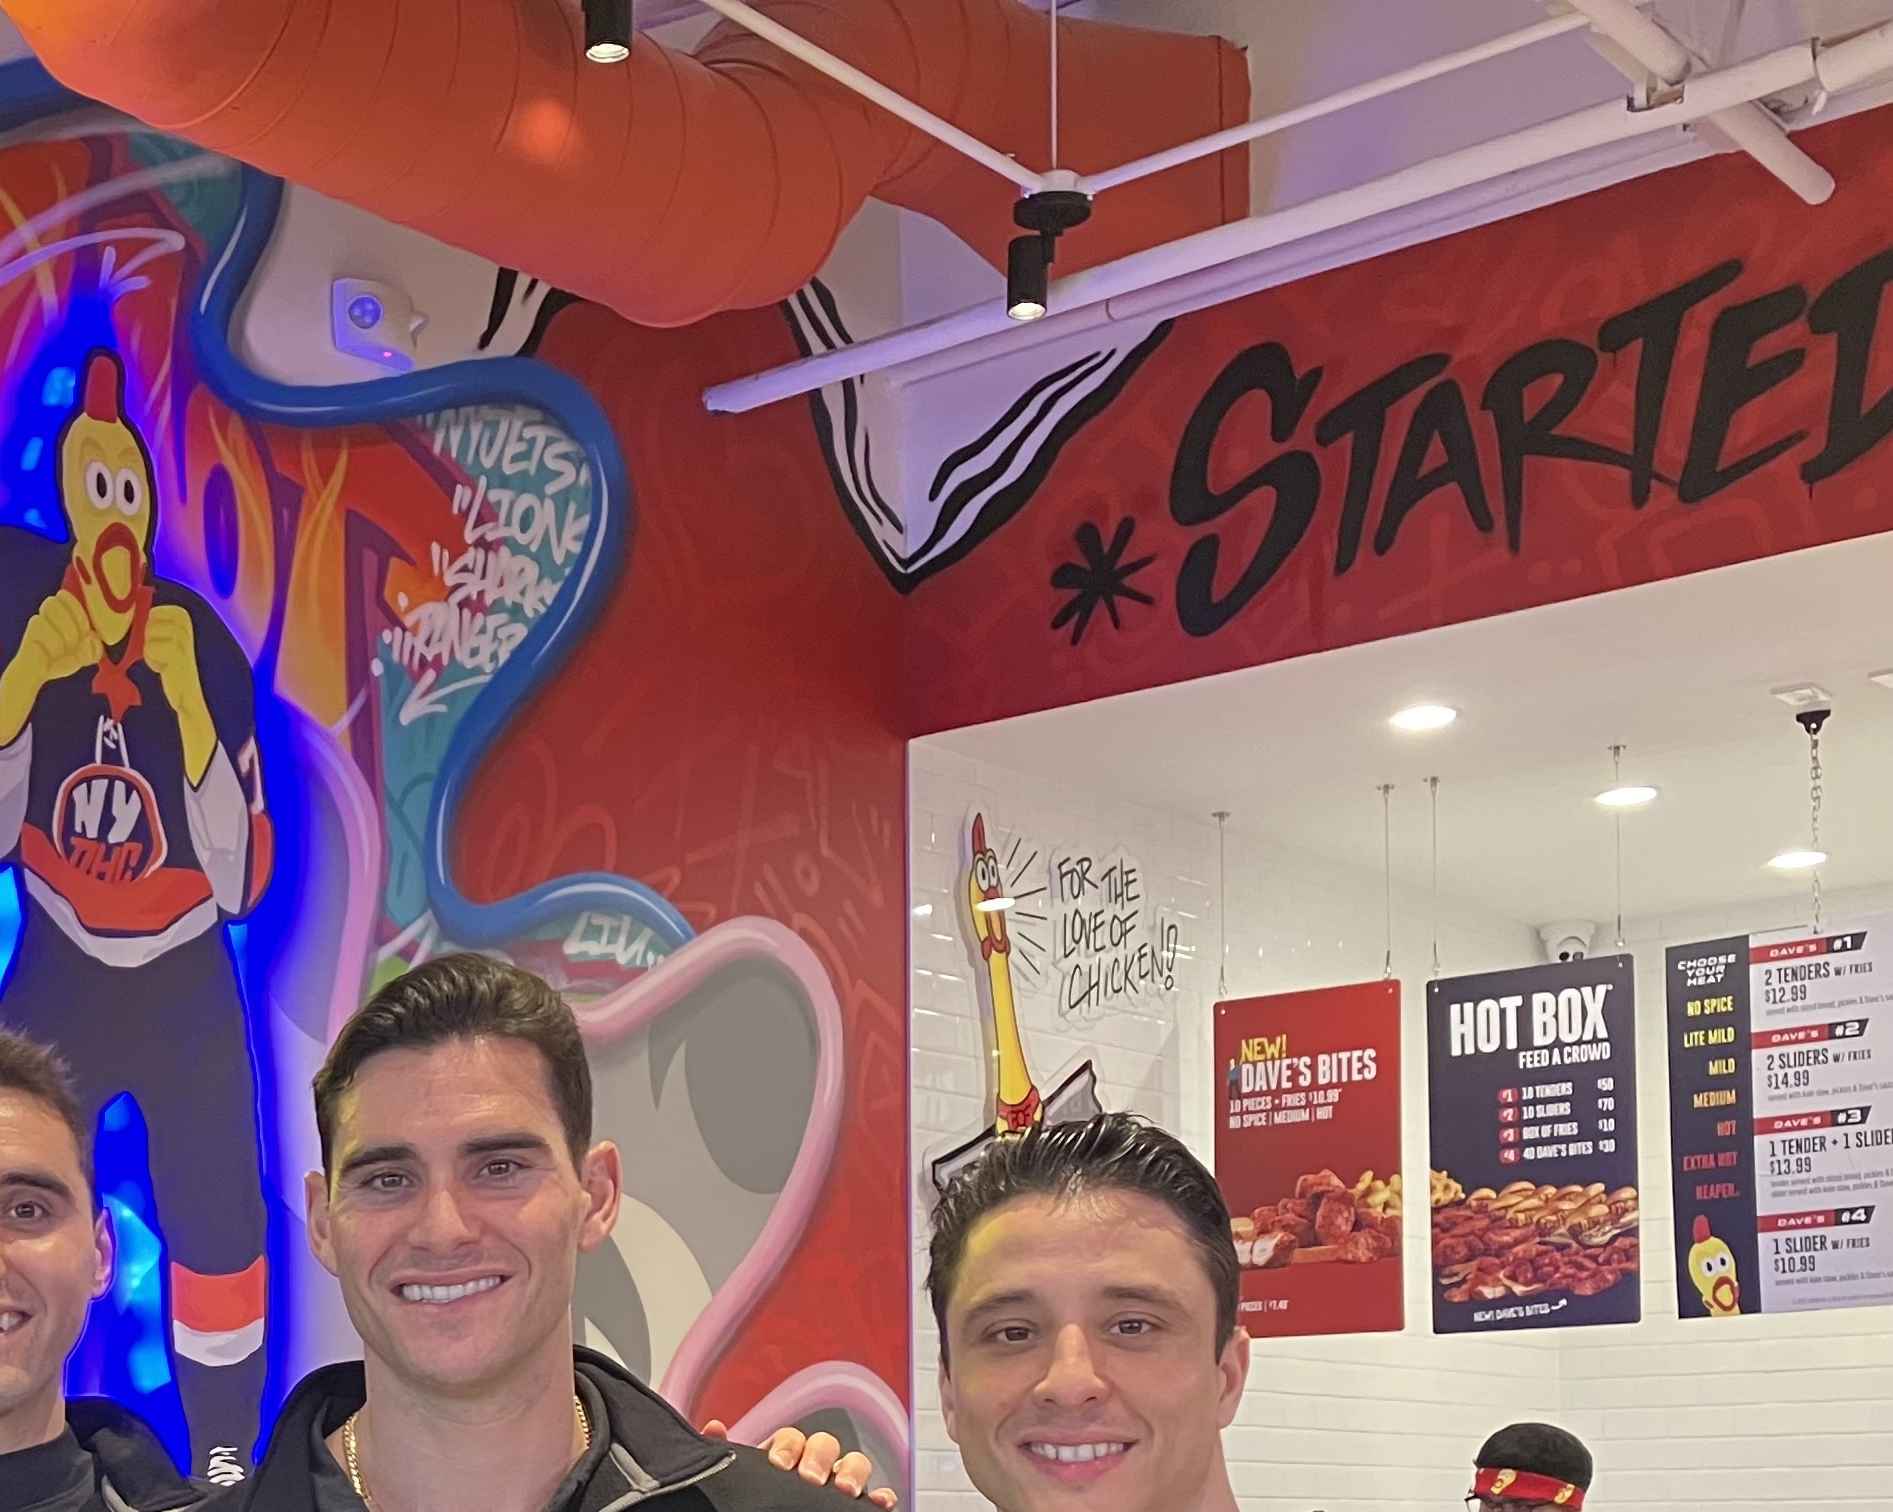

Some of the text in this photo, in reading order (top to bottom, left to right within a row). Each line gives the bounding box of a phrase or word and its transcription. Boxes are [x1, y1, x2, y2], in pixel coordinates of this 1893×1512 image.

[71, 778, 142, 843] NY
[1058, 856, 1141, 911] FOR THE
[1063, 908, 1139, 959] LOVE OF
[1769, 943, 1817, 958] DAVE'S
[1068, 916, 1178, 1010] CHICKEN!
[1677, 953, 1736, 970] CHOOSE
[1687, 965, 1725, 977] YOUR
[1687, 974, 1724, 987] HEAT
[1765, 969, 1772, 986] 2
[1776, 961, 1830, 985] TENDERS
[1849, 962, 1873, 975] FRIES
[1765, 984, 1807, 1005] $12.99
[1687, 996, 1733, 1017] NO SPICE
[1450, 984, 1610, 1057] HOT BOX
[1683, 1026, 1735, 1048] LITE MILD
[1771, 1021, 1860, 1043] DAVE'S #2
[1241, 1034, 1287, 1062] NEW!
[1519, 1042, 1611, 1069] FEED A CROWD
[1709, 1058, 1735, 1076] MILD
[1767, 1054, 1775, 1071] 2
[1778, 1048, 1828, 1070] SLIDERS
[1848, 1049, 1871, 1061] FRIES
[1241, 1048, 1377, 1093] DAVE'S BITES
[1767, 1069, 1810, 1090] $14.99
[1522, 1086, 1533, 1100] 10
[1535, 1082, 1573, 1098] TENDERS
[1693, 1088, 1736, 1108] MEDIUM
[1229, 1100, 1241, 1114] 10
[1242, 1095, 1272, 1112] PIECES
[1281, 1092, 1306, 1108] FRIES
[1522, 1105, 1533, 1120] 10
[1535, 1102, 1571, 1118] SLIDERS
[1597, 1097, 1615, 1111] $70
[1229, 1105, 1333, 1129] NO SPICE MEDIUM HOT
[1773, 1109, 1862, 1129] DAVE'S #3
[1522, 1126, 1540, 1140] BOX
[1541, 1125, 1552, 1137] OF
[1553, 1121, 1579, 1136] FRIES
[1598, 1118, 1615, 1132] $10
[1717, 1120, 1736, 1136] HOT
[1536, 1144, 1567, 1160] DAVE'S
[1568, 1141, 1594, 1157] BITES
[1769, 1140, 1777, 1157] 1
[1781, 1135, 1827, 1156] TENDER
[1843, 1132, 1851, 1149] 1
[1855, 1128, 1893, 1149] SLIDE
[1683, 1151, 1737, 1172] EXTRA HOT
[1769, 1156, 1812, 1176] $13.99
[1777, 1208, 1867, 1228] DAVE'S #4
[1772, 1239, 1781, 1255] 1
[1785, 1234, 1828, 1254] SLIDER
[1846, 1236, 1870, 1248] FRIES
[1774, 1255, 1816, 1274] $10.99
